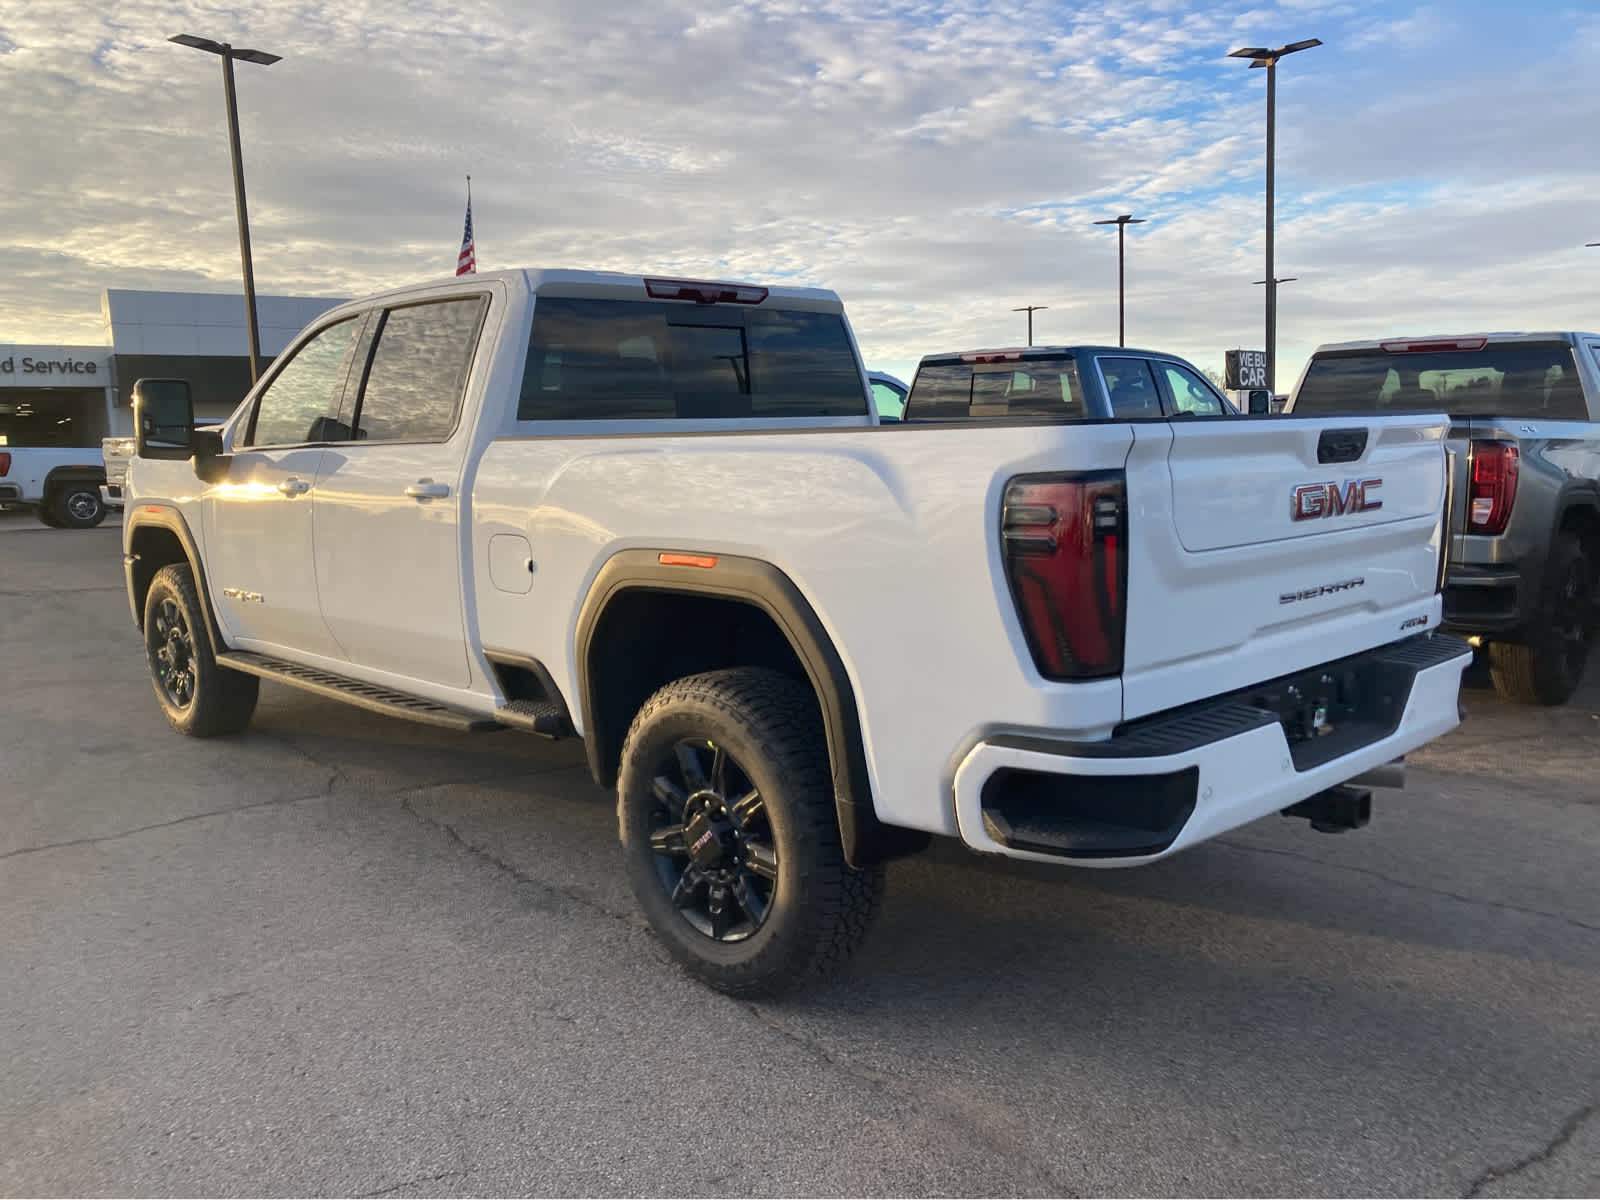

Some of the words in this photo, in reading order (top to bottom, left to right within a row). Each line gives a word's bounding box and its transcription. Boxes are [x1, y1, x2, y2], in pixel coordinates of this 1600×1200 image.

[22, 356, 97, 375] Service
[1240, 352, 1254, 367] WE
[1290, 479, 1383, 522] GMC
[1279, 576, 1365, 605] SIERRA
